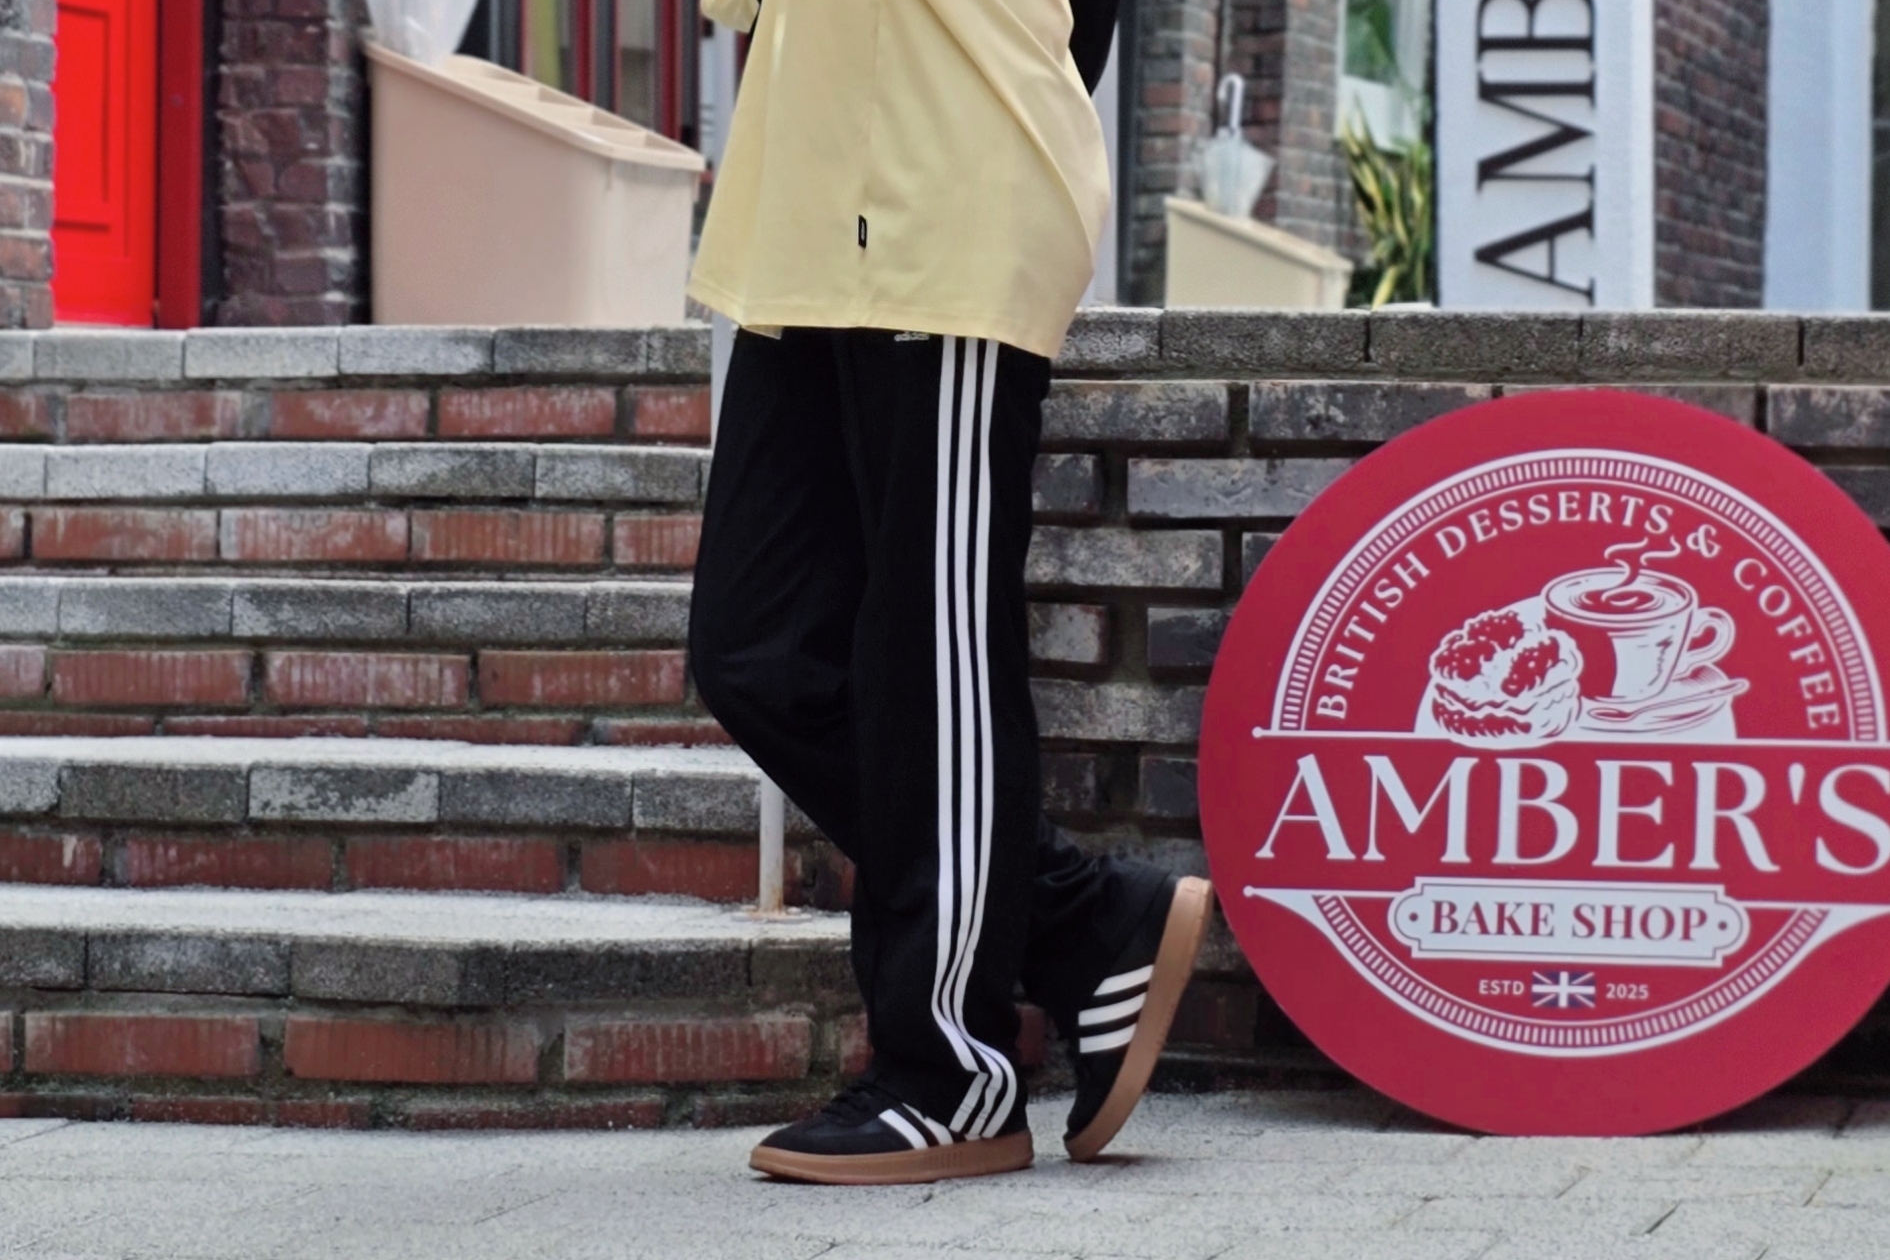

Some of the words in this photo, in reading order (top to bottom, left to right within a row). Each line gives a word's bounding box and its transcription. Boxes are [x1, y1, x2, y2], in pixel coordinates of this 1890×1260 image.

[1316, 551, 1430, 721] BRITISH
[1434, 490, 1674, 560] DESSERTS
[1686, 524, 1722, 558] &
[1732, 557, 1841, 730] COFFEE
[1254, 753, 1890, 875] AMBER'S
[1430, 899, 1556, 937] BAKE
[1571, 903, 1709, 942] SHOP
[1478, 978, 1525, 998] ESTD
[1605, 982, 1650, 1001] 2025
